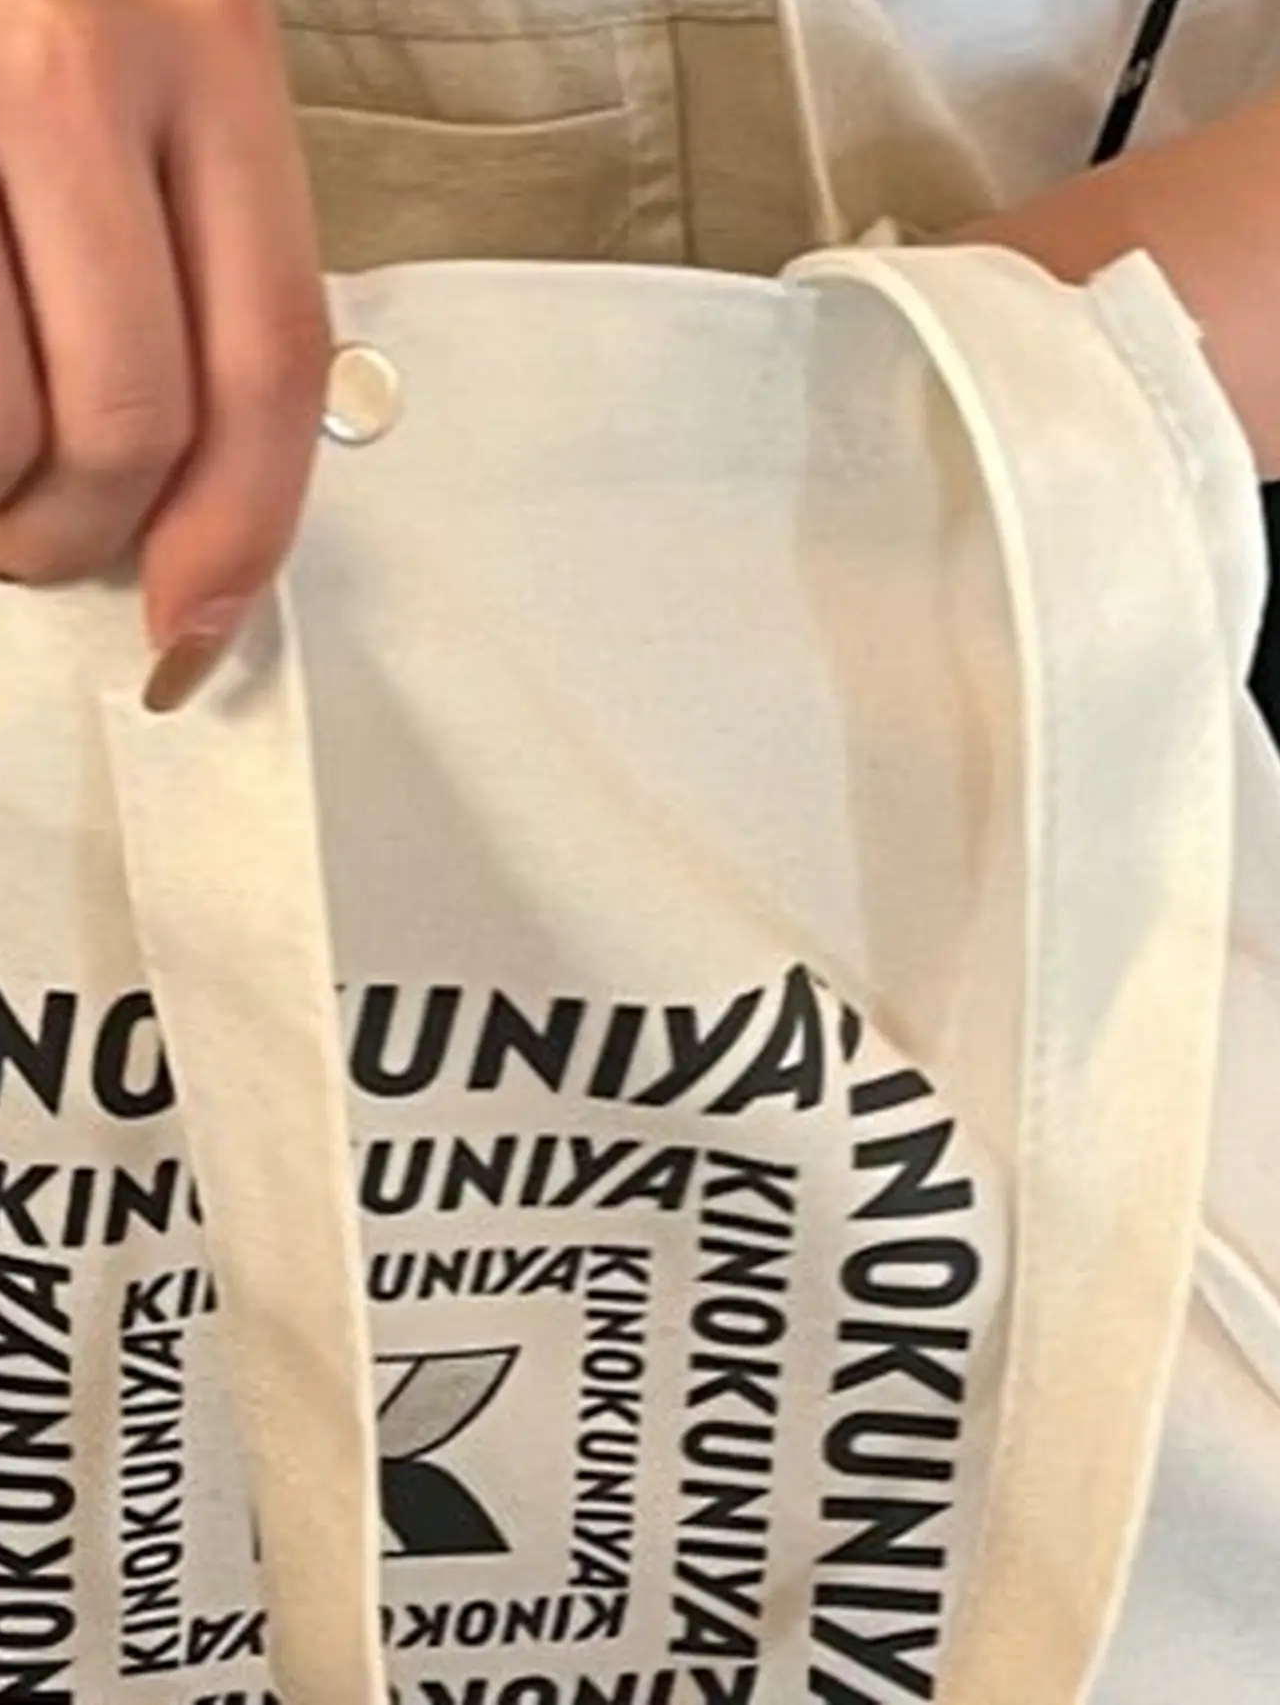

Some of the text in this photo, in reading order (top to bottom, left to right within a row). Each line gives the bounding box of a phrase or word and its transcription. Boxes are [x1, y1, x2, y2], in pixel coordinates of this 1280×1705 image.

[120, 1329, 184, 1676] KINOKUNIYA
[568, 1245, 652, 1589] KINOKUNIYA
[669, 1149, 799, 1659] KINOKUNIYA
